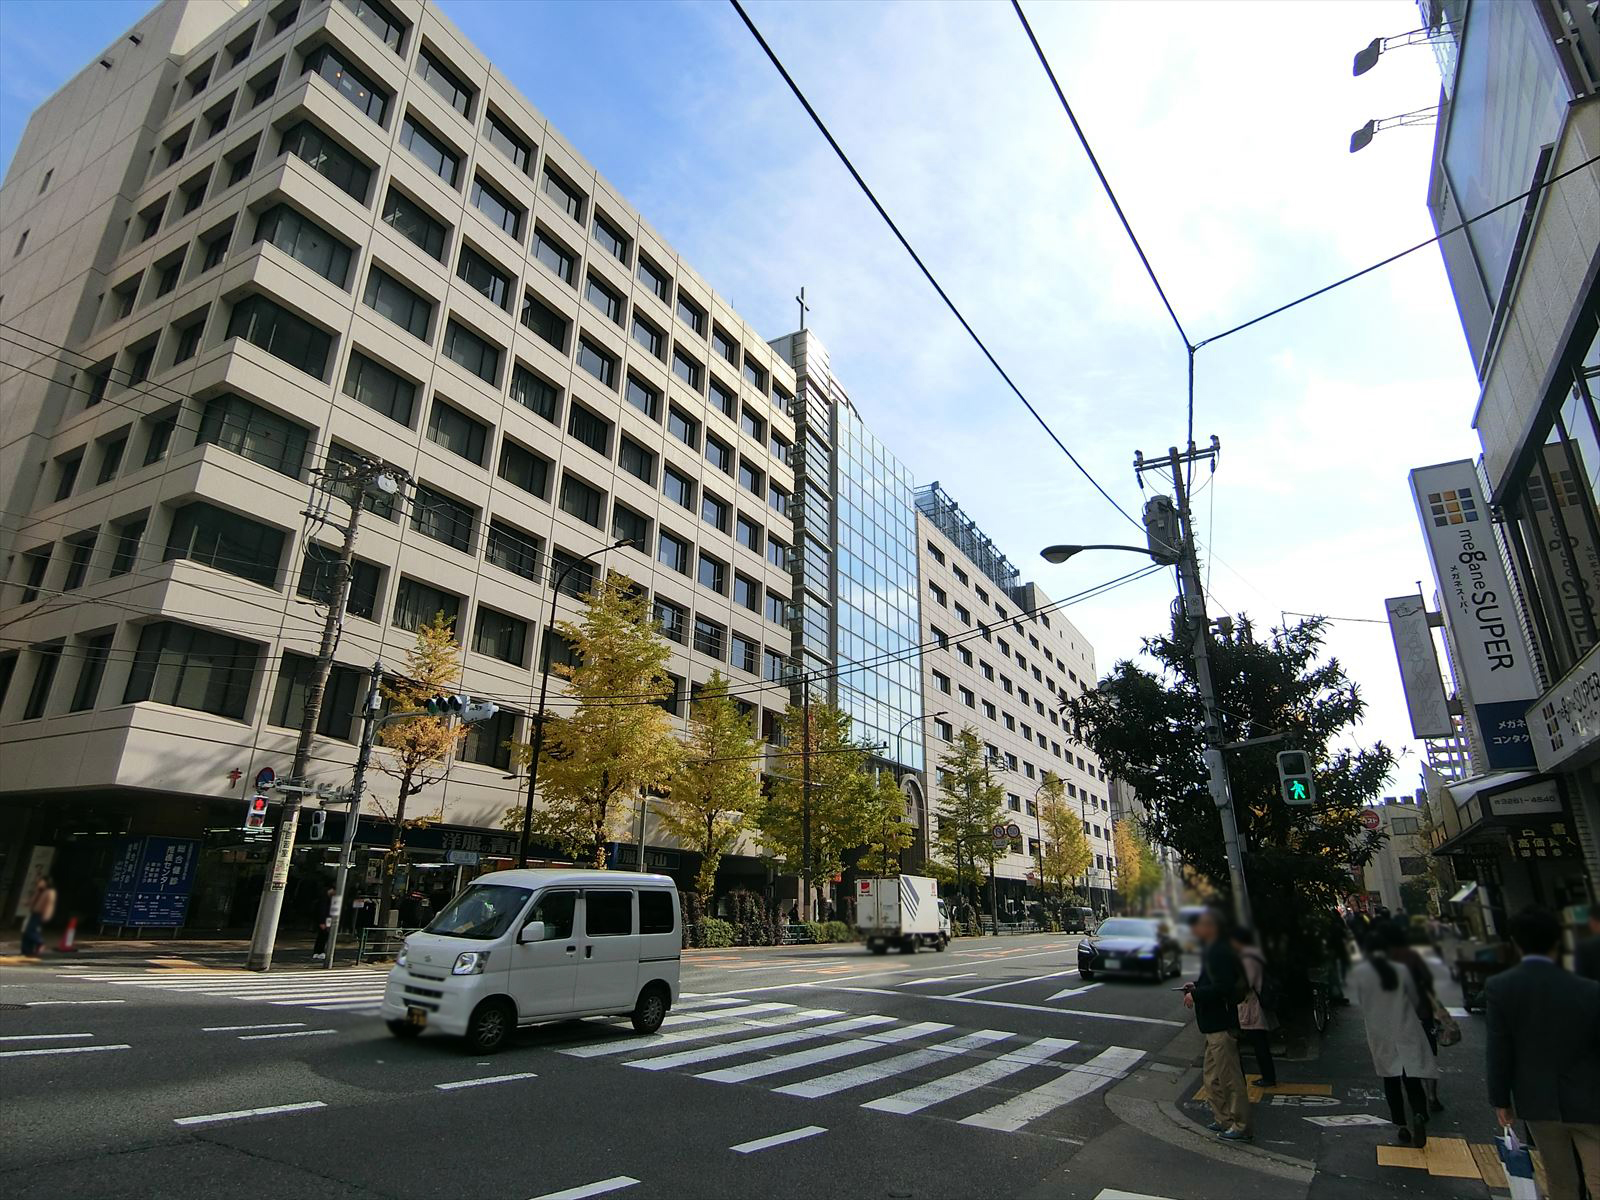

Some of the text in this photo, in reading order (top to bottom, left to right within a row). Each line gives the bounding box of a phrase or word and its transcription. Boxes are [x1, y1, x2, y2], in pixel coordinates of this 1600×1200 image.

[1449, 564, 1469, 615] メガネスーパー
[1458, 529, 1515, 672] meganeSUPER
[1498, 719, 1527, 730] メガネ
[442, 832, 522, 855] 洋服の青山
